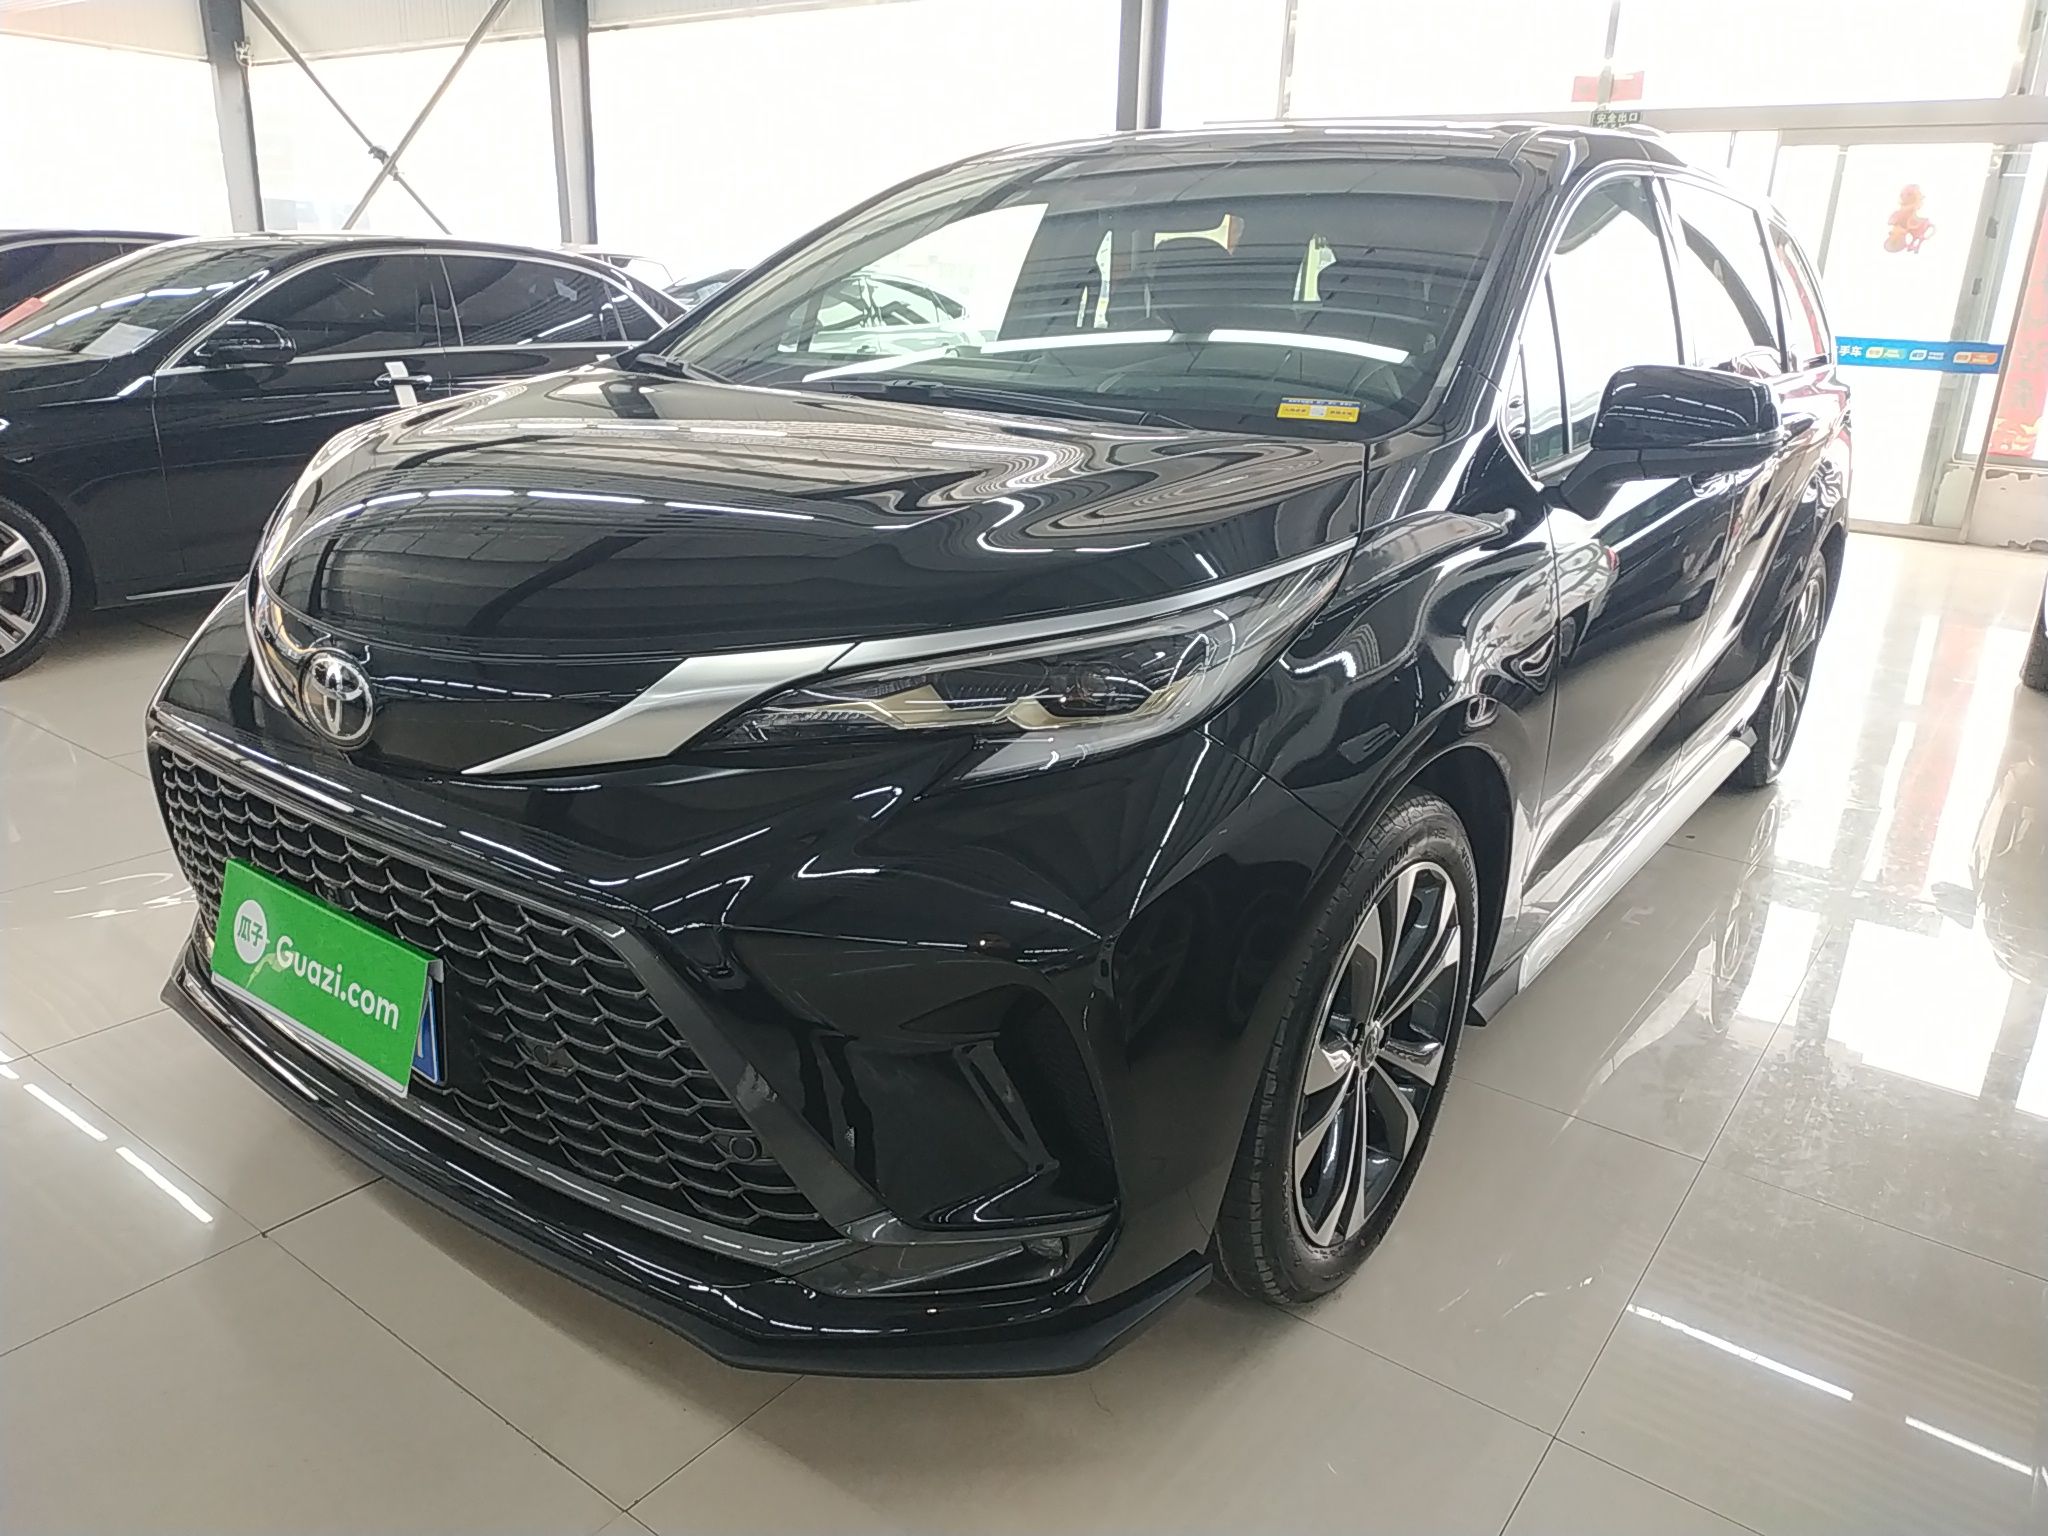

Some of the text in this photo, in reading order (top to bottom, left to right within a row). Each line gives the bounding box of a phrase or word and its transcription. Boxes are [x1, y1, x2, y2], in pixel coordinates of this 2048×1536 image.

[1597, 112, 1638, 124] 安全出口
[1835, 345, 1863, 358] 手车
[237, 914, 264, 947] 瓜子
[276, 935, 400, 1030] Guazi.com
